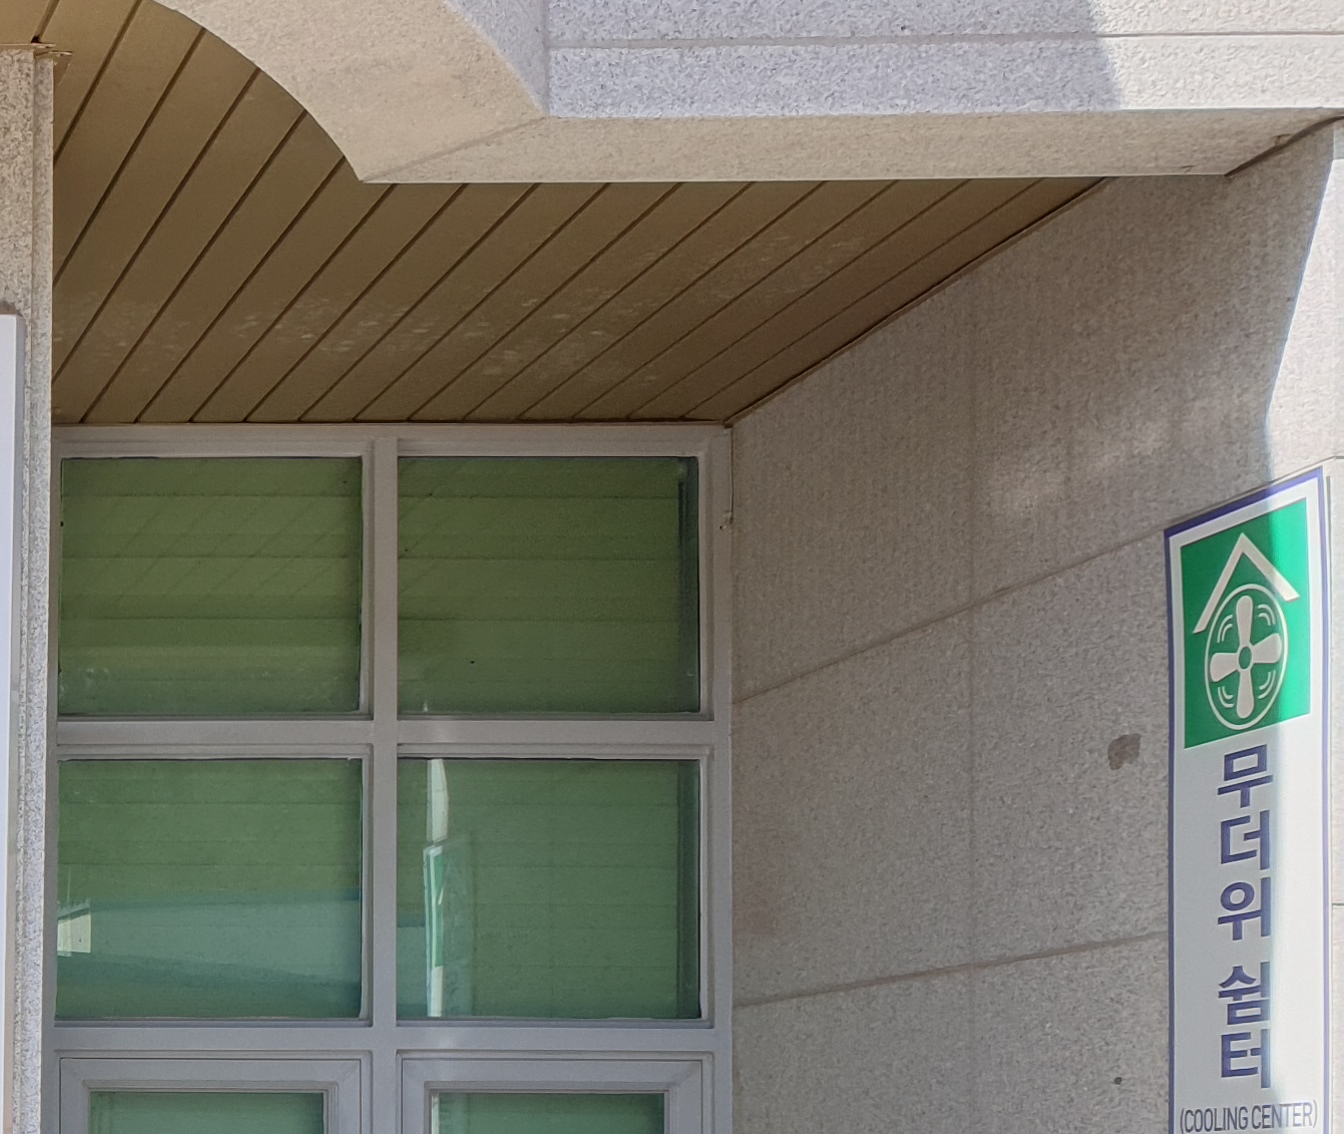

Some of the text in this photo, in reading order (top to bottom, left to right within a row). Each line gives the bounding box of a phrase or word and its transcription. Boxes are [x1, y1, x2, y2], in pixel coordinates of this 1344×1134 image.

[1217, 743, 1274, 1090] 무더위 쉼터
[1180, 1099, 1318, 1134] (COOLING CENTER)
